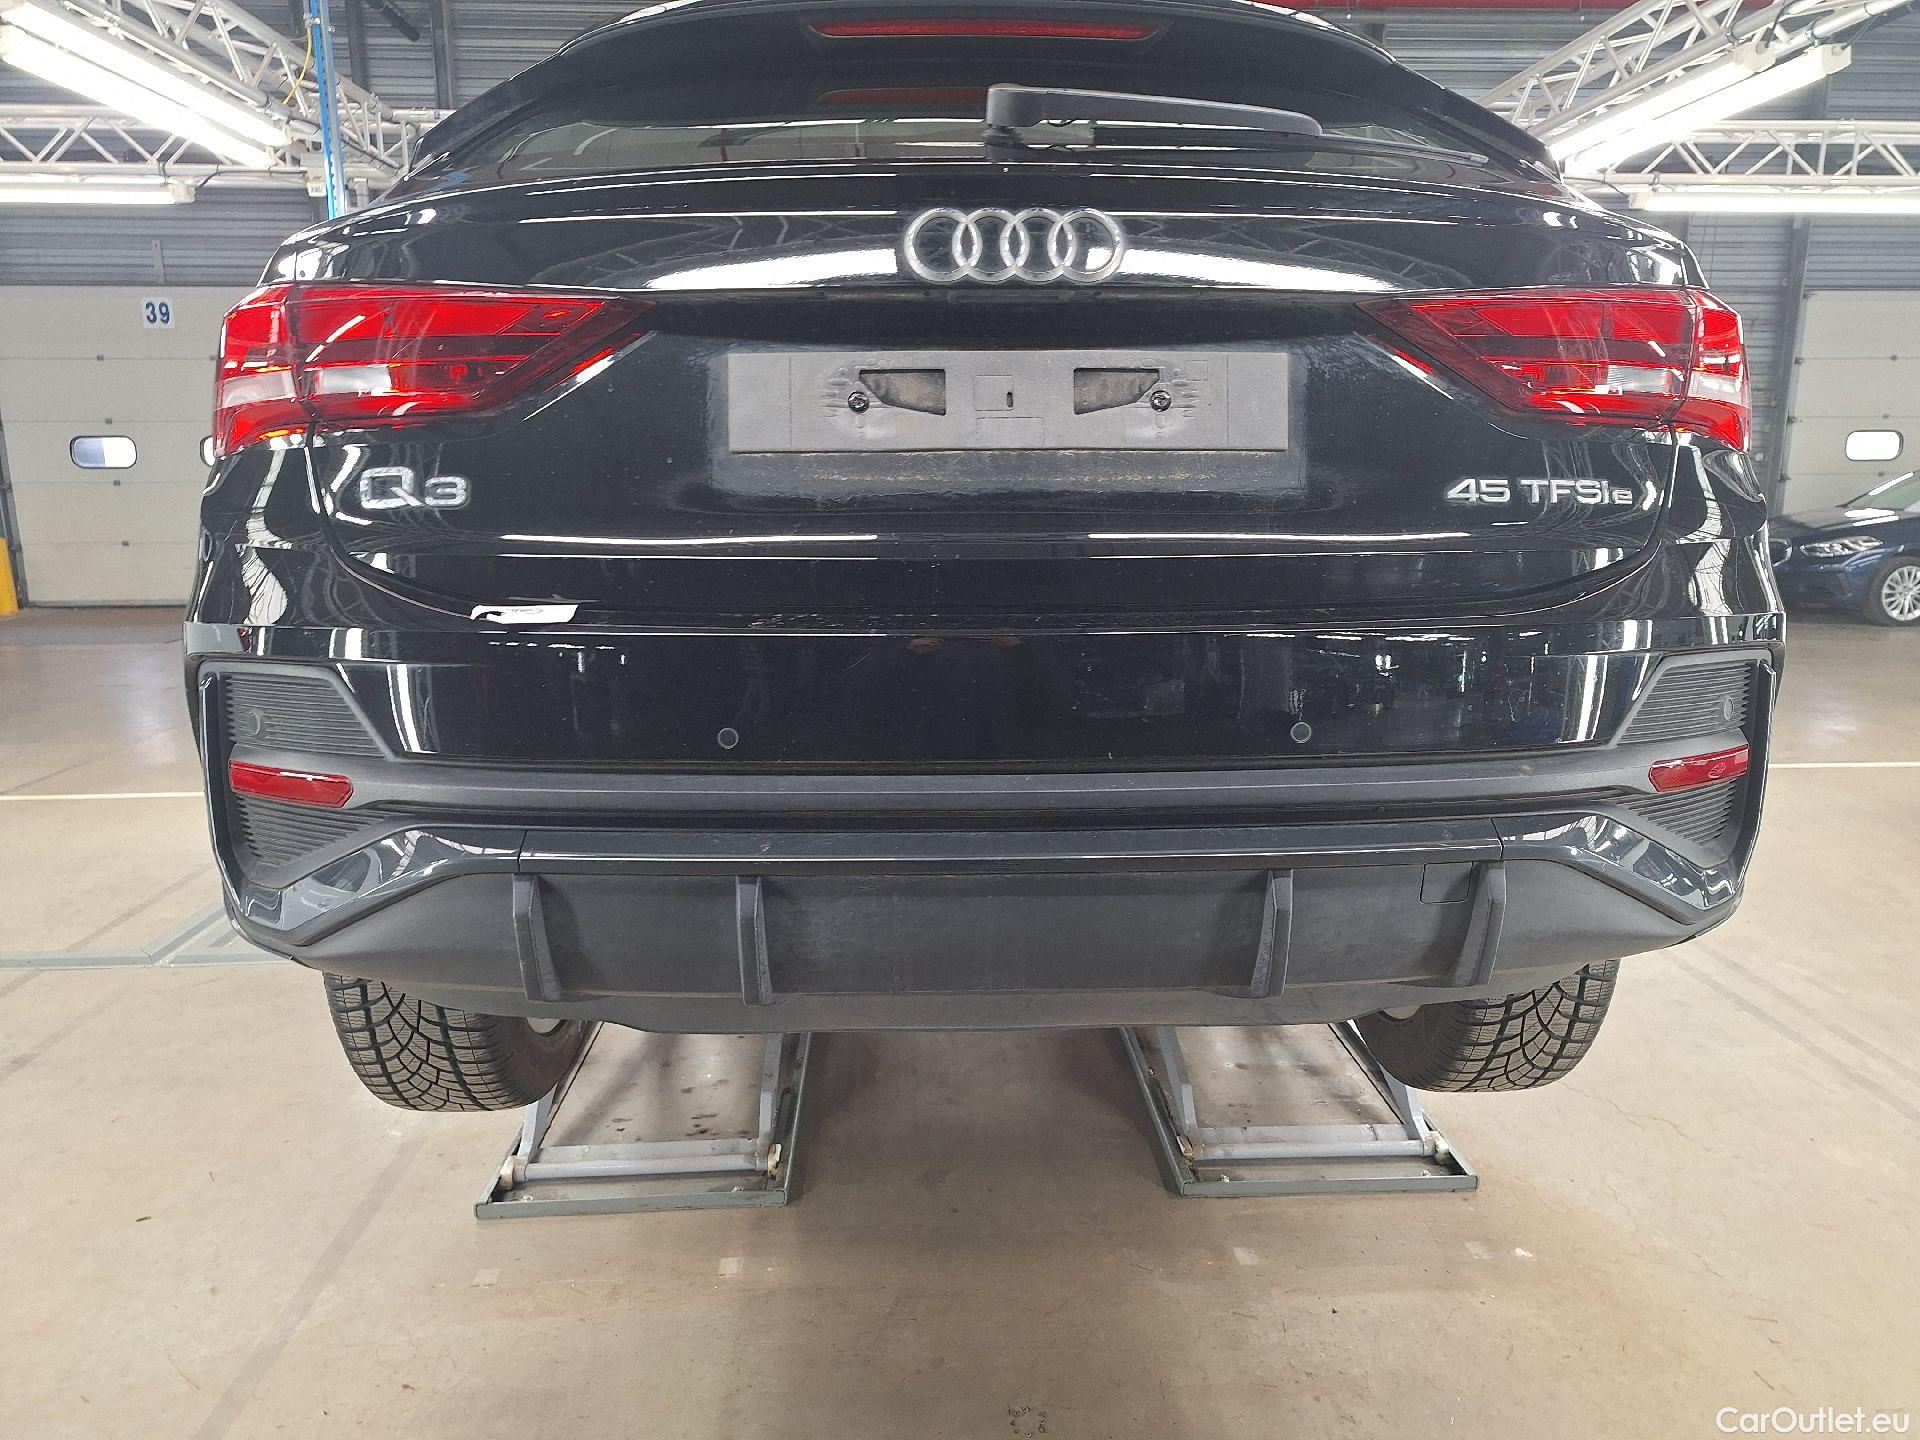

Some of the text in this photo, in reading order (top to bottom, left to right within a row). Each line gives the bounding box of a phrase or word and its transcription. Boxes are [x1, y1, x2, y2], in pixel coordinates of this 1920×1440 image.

[145, 302, 170, 324] 39
[360, 466, 467, 509] Q3
[1447, 478, 1511, 503] 45
